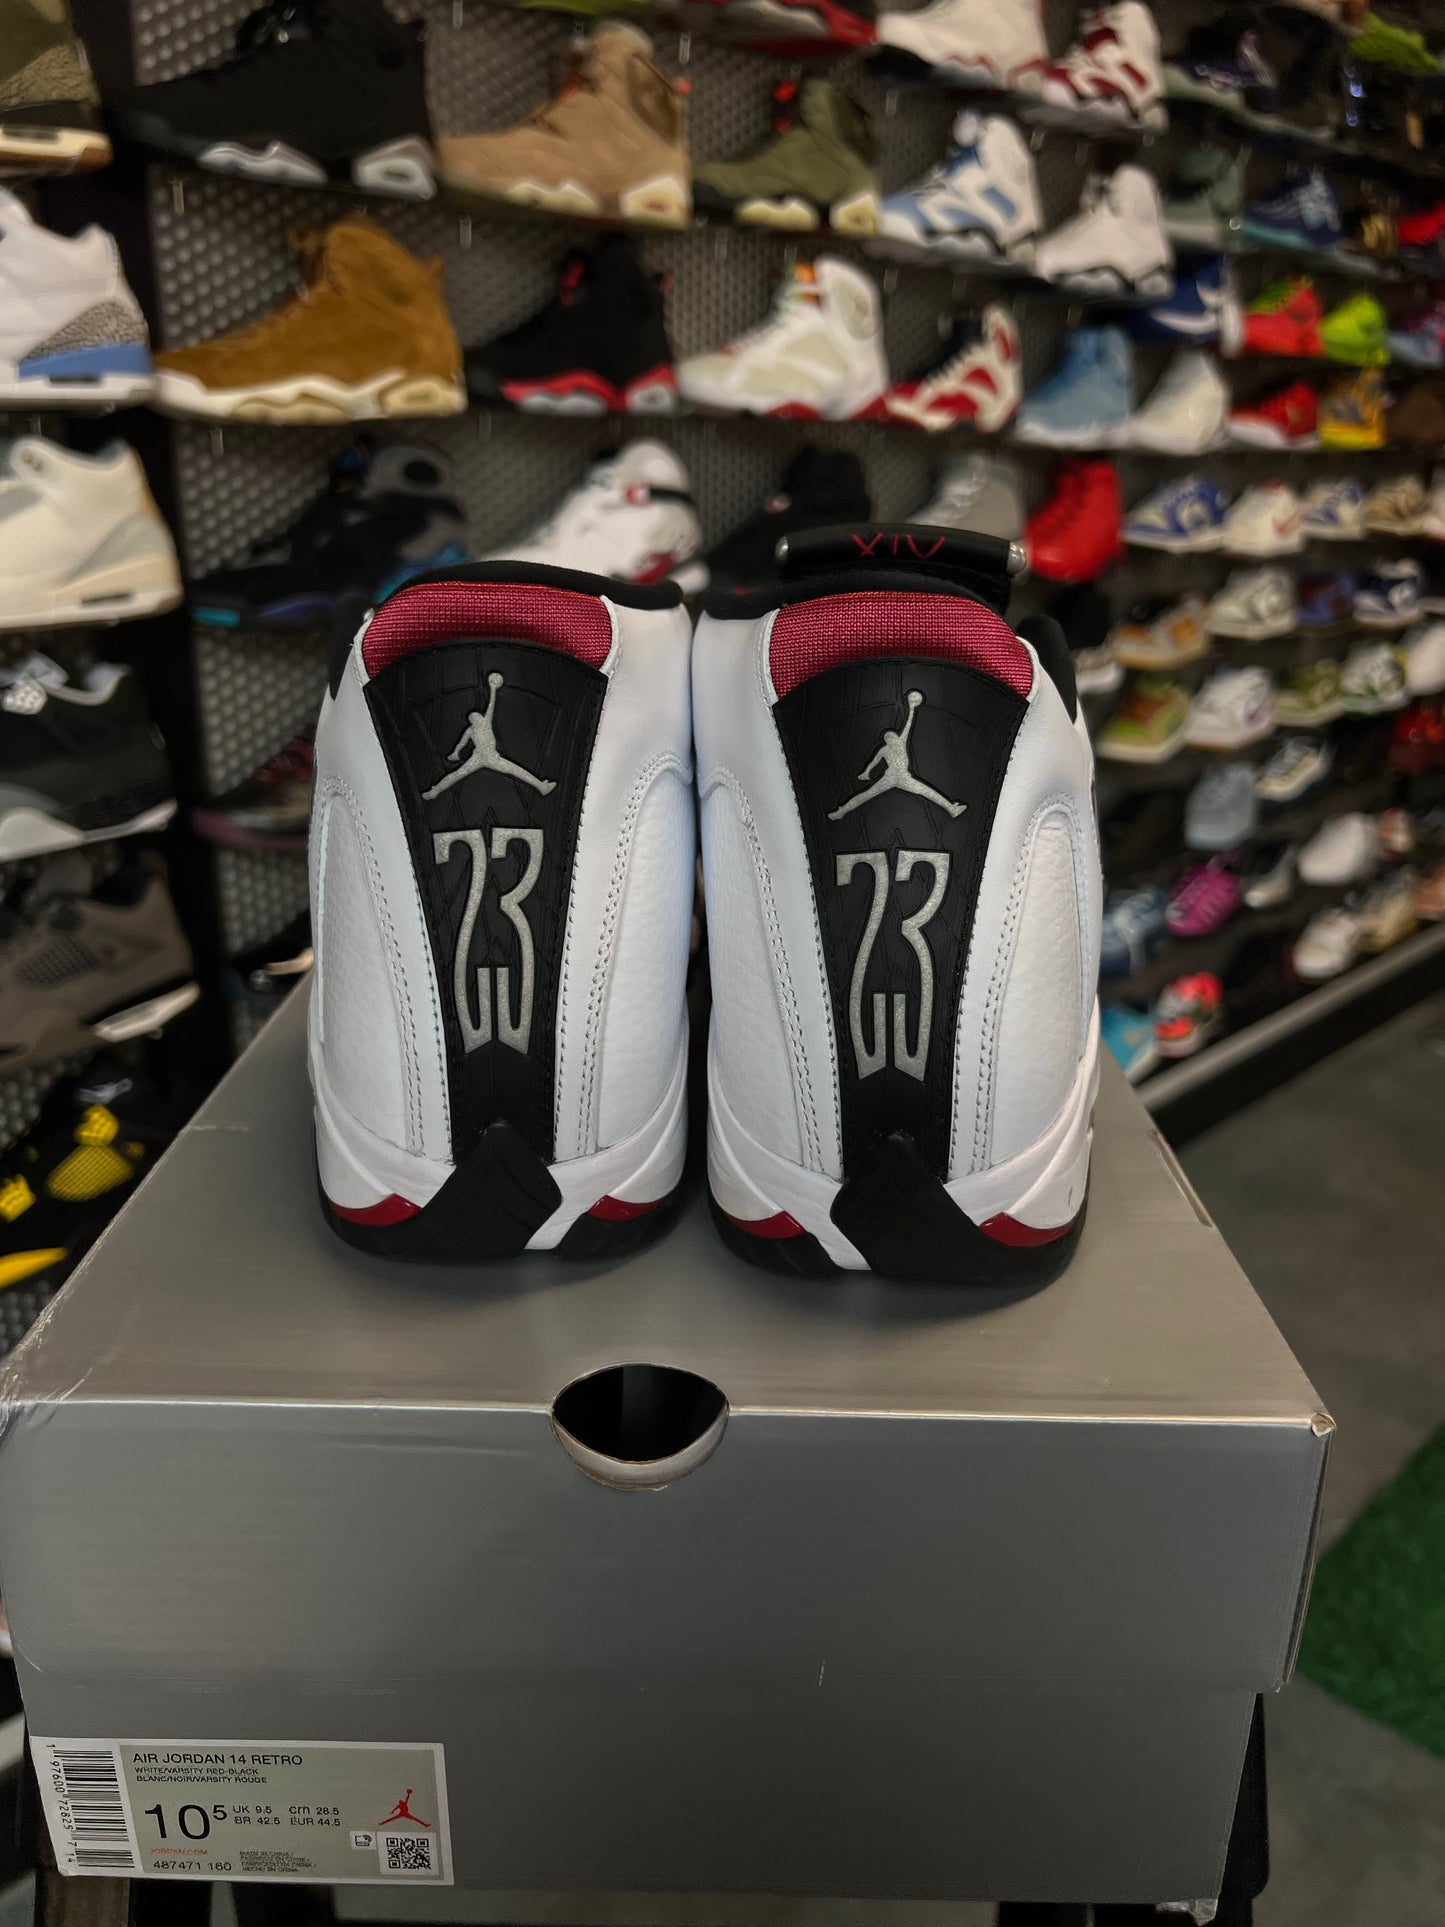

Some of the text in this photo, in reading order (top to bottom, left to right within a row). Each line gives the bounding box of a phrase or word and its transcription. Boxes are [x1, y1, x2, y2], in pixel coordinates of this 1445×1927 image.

[852, 533, 946, 559] XIV
[433, 828, 544, 1055] 23
[836, 850, 950, 1081] 23
[133, 1753, 303, 1765] AIR JORDAN 14 RETRO
[49, 1760, 66, 1793] 97600
[58, 1800, 74, 1830] 72825
[232, 1805, 250, 1814] UK
[255, 1805, 273, 1814] 9.5
[316, 1806, 340, 1815] 28.5
[234, 1816, 341, 1826] BR 42.5 EUR 44.5
[153, 1861, 201, 1870] 487471
[208, 1862, 232, 1871] 160
